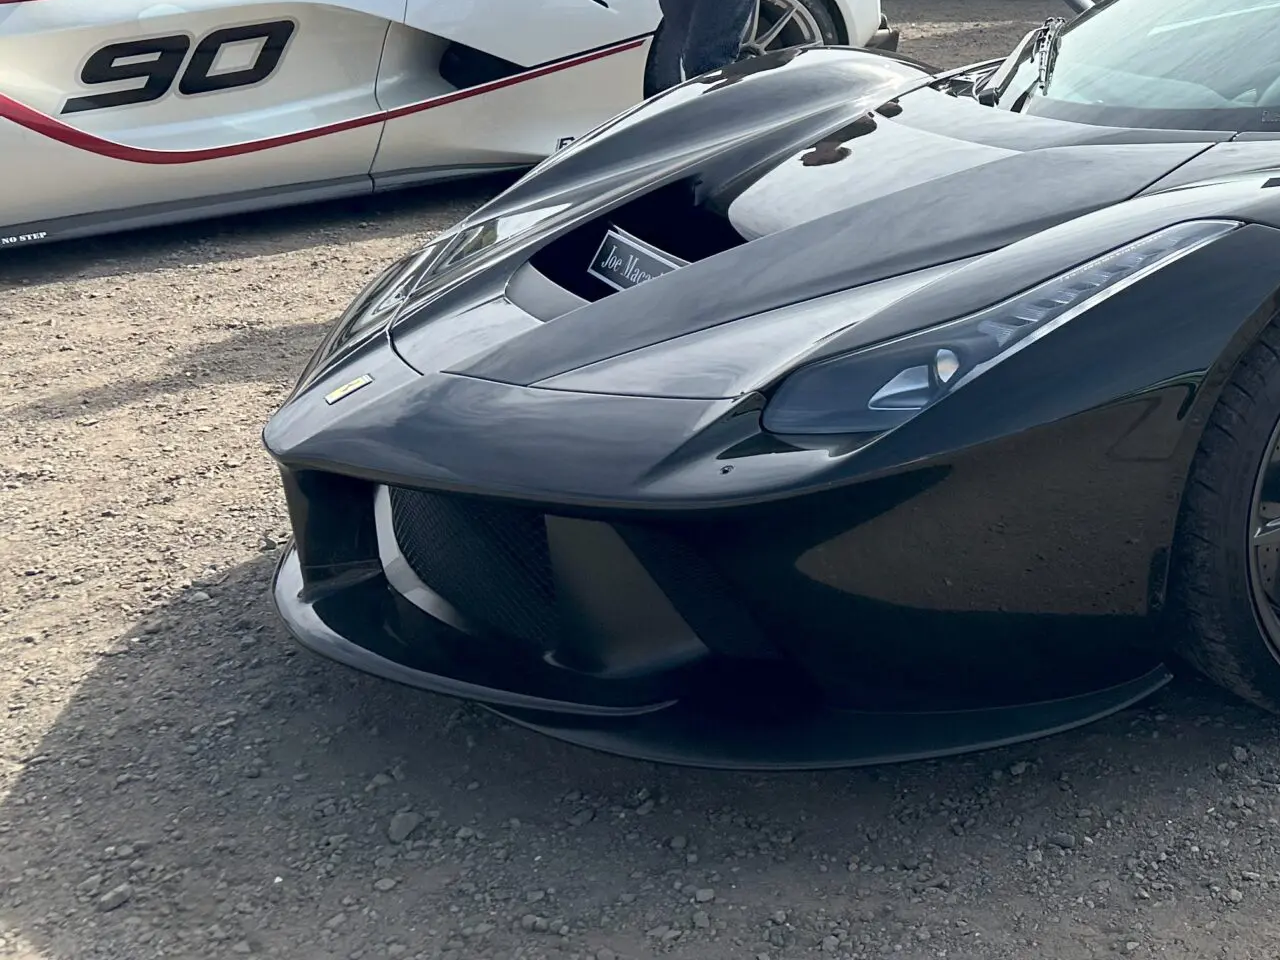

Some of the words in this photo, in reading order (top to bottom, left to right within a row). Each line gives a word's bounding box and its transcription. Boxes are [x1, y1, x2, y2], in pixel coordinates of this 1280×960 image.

[60, 19, 296, 115] 90
[1, 236, 18, 245] NO
[19, 231, 47, 242] STEP
[601, 245, 623, 272] Joe
[620, 254, 657, 284] Maca
